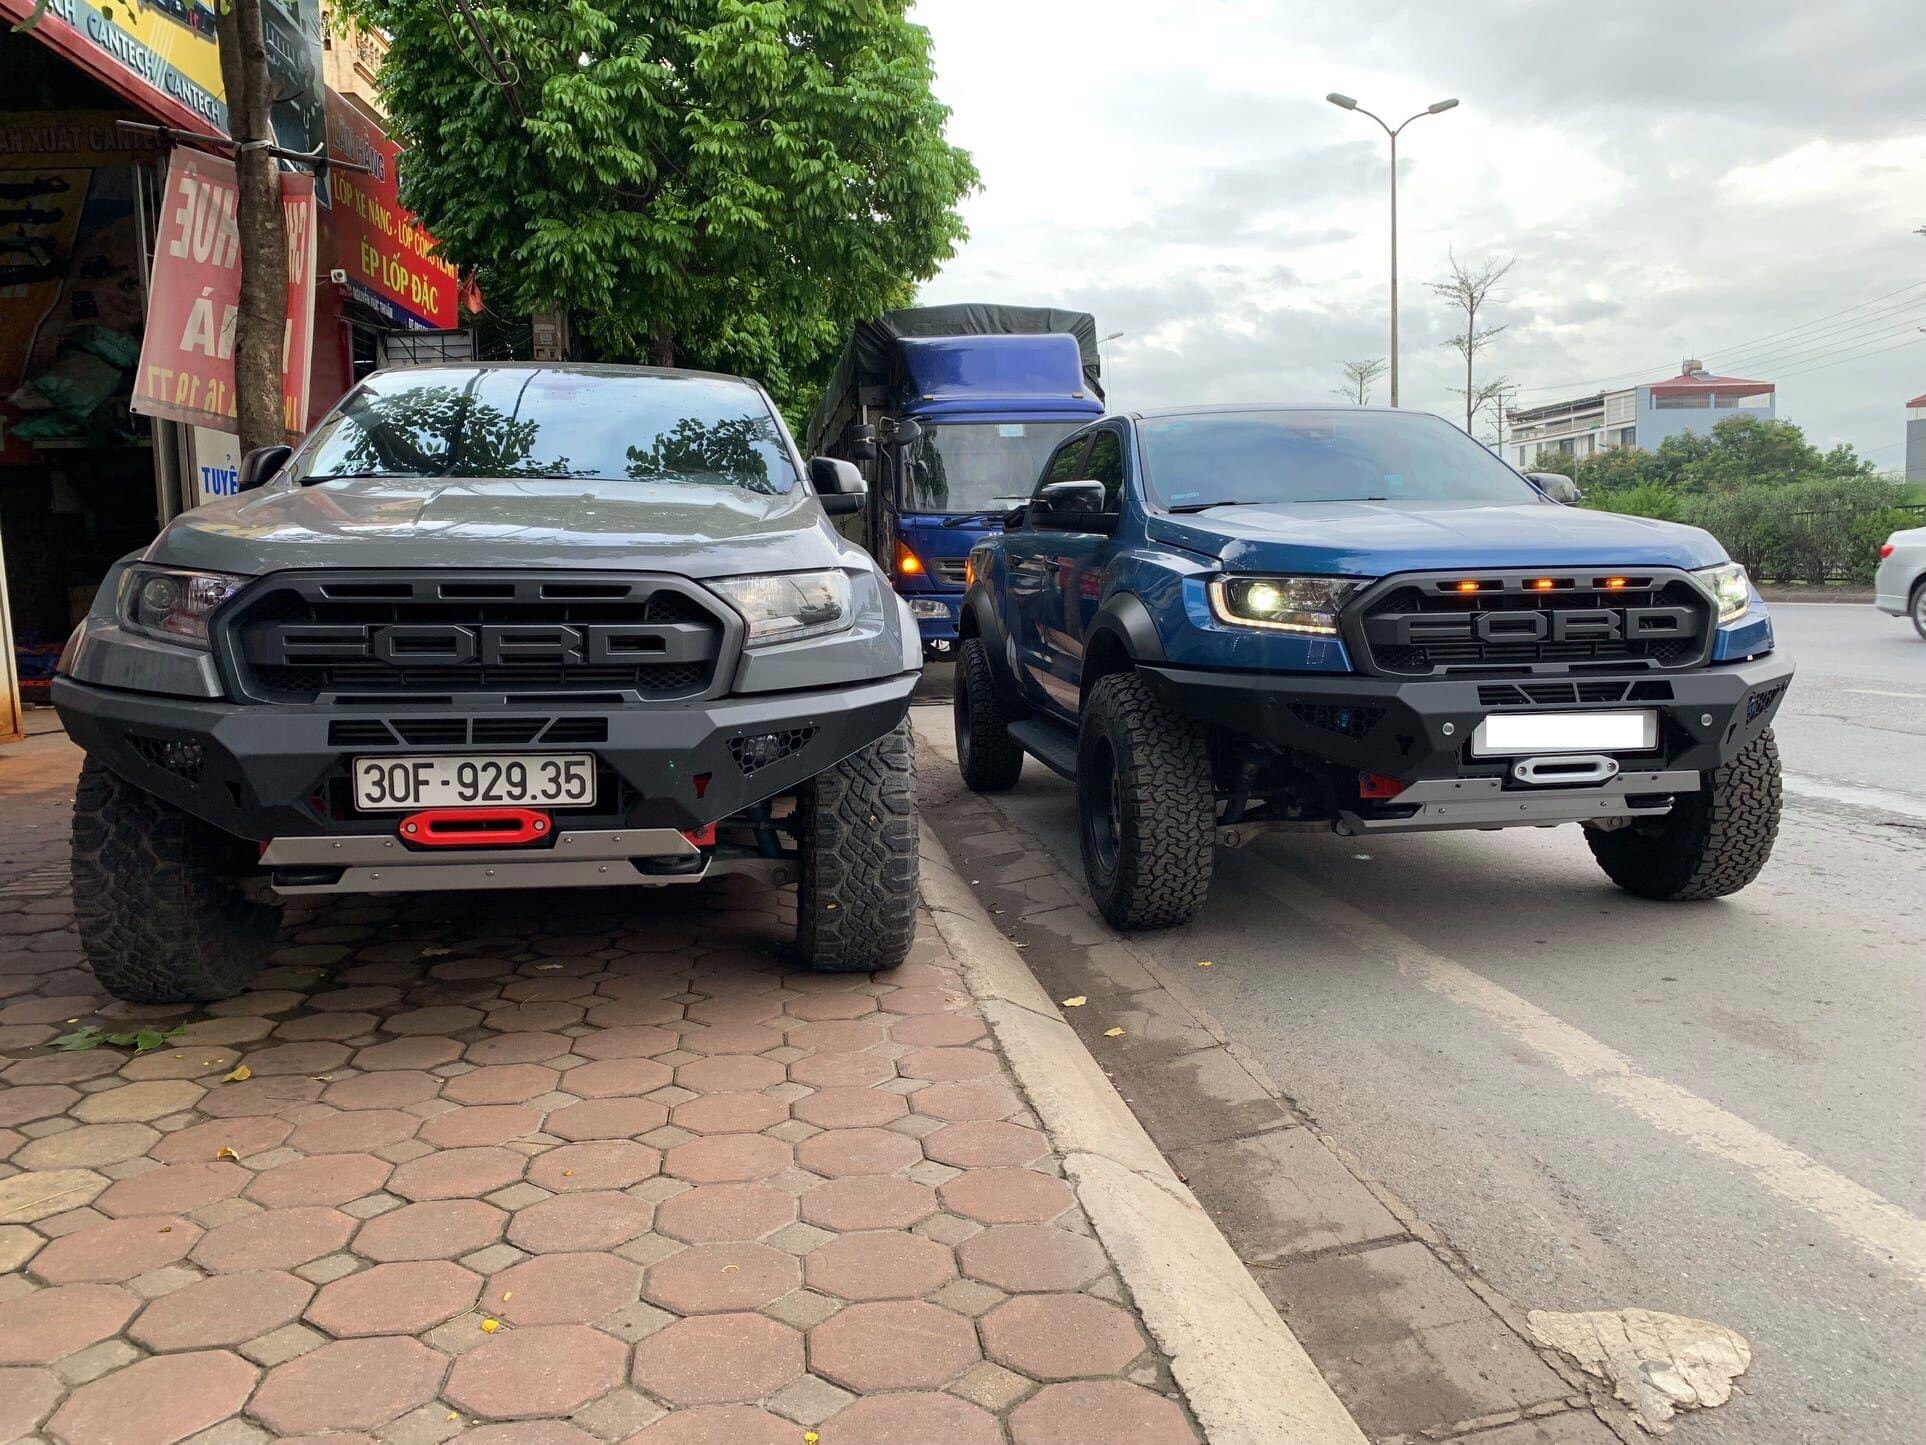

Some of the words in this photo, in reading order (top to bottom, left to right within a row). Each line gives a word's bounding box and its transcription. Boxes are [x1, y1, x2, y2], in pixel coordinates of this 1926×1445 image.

[87, 13, 154, 80] CANTECH
[165, 69, 219, 126] CANTECH
[354, 188, 367, 219] XE
[368, 197, 393, 236] NÂNG
[361, 235, 380, 278] ÉP
[382, 252, 409, 296] LỐP
[411, 272, 439, 316] ĐẶC
[268, 623, 695, 666] FORD
[1395, 605, 1698, 646] FORD
[362, 758, 588, 804] 30F-929.35
